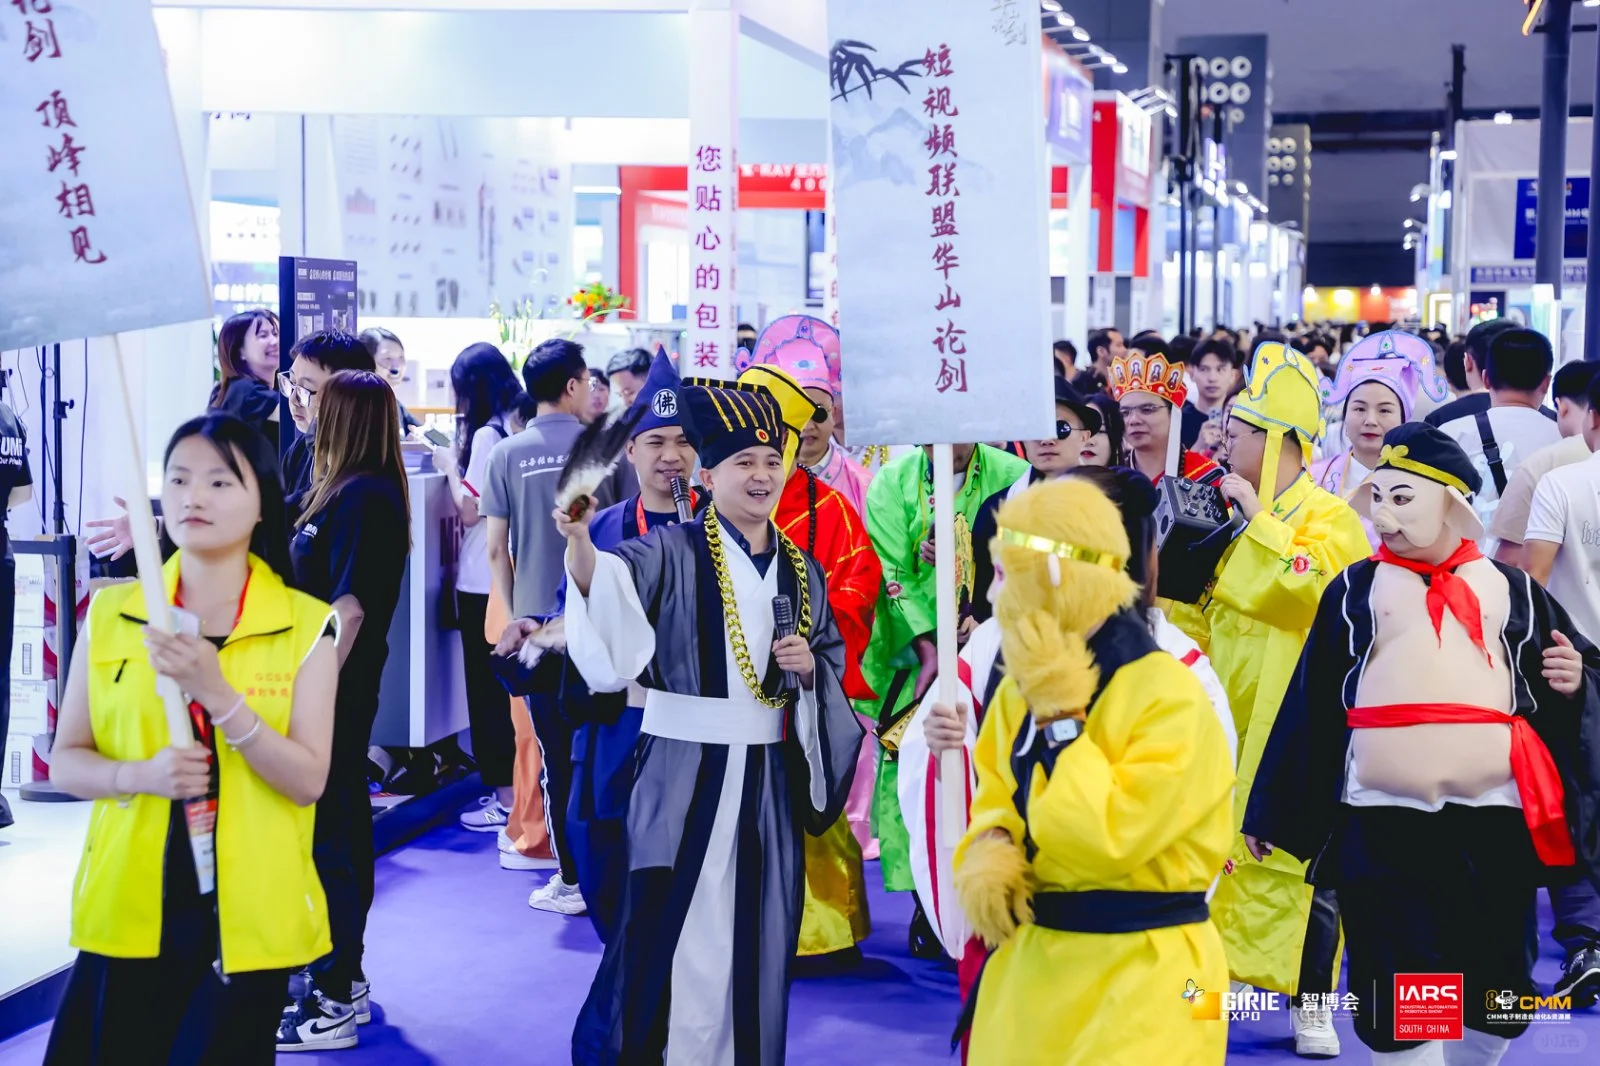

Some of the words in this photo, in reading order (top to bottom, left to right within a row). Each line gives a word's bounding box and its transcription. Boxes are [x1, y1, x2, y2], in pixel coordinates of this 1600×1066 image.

[35, 89, 108, 265] 顶峰相见
[694, 145, 722, 369] 您贴心的包装
[921, 43, 968, 394] 短视频联盟华山论剑
[654, 392, 676, 414] 佛
